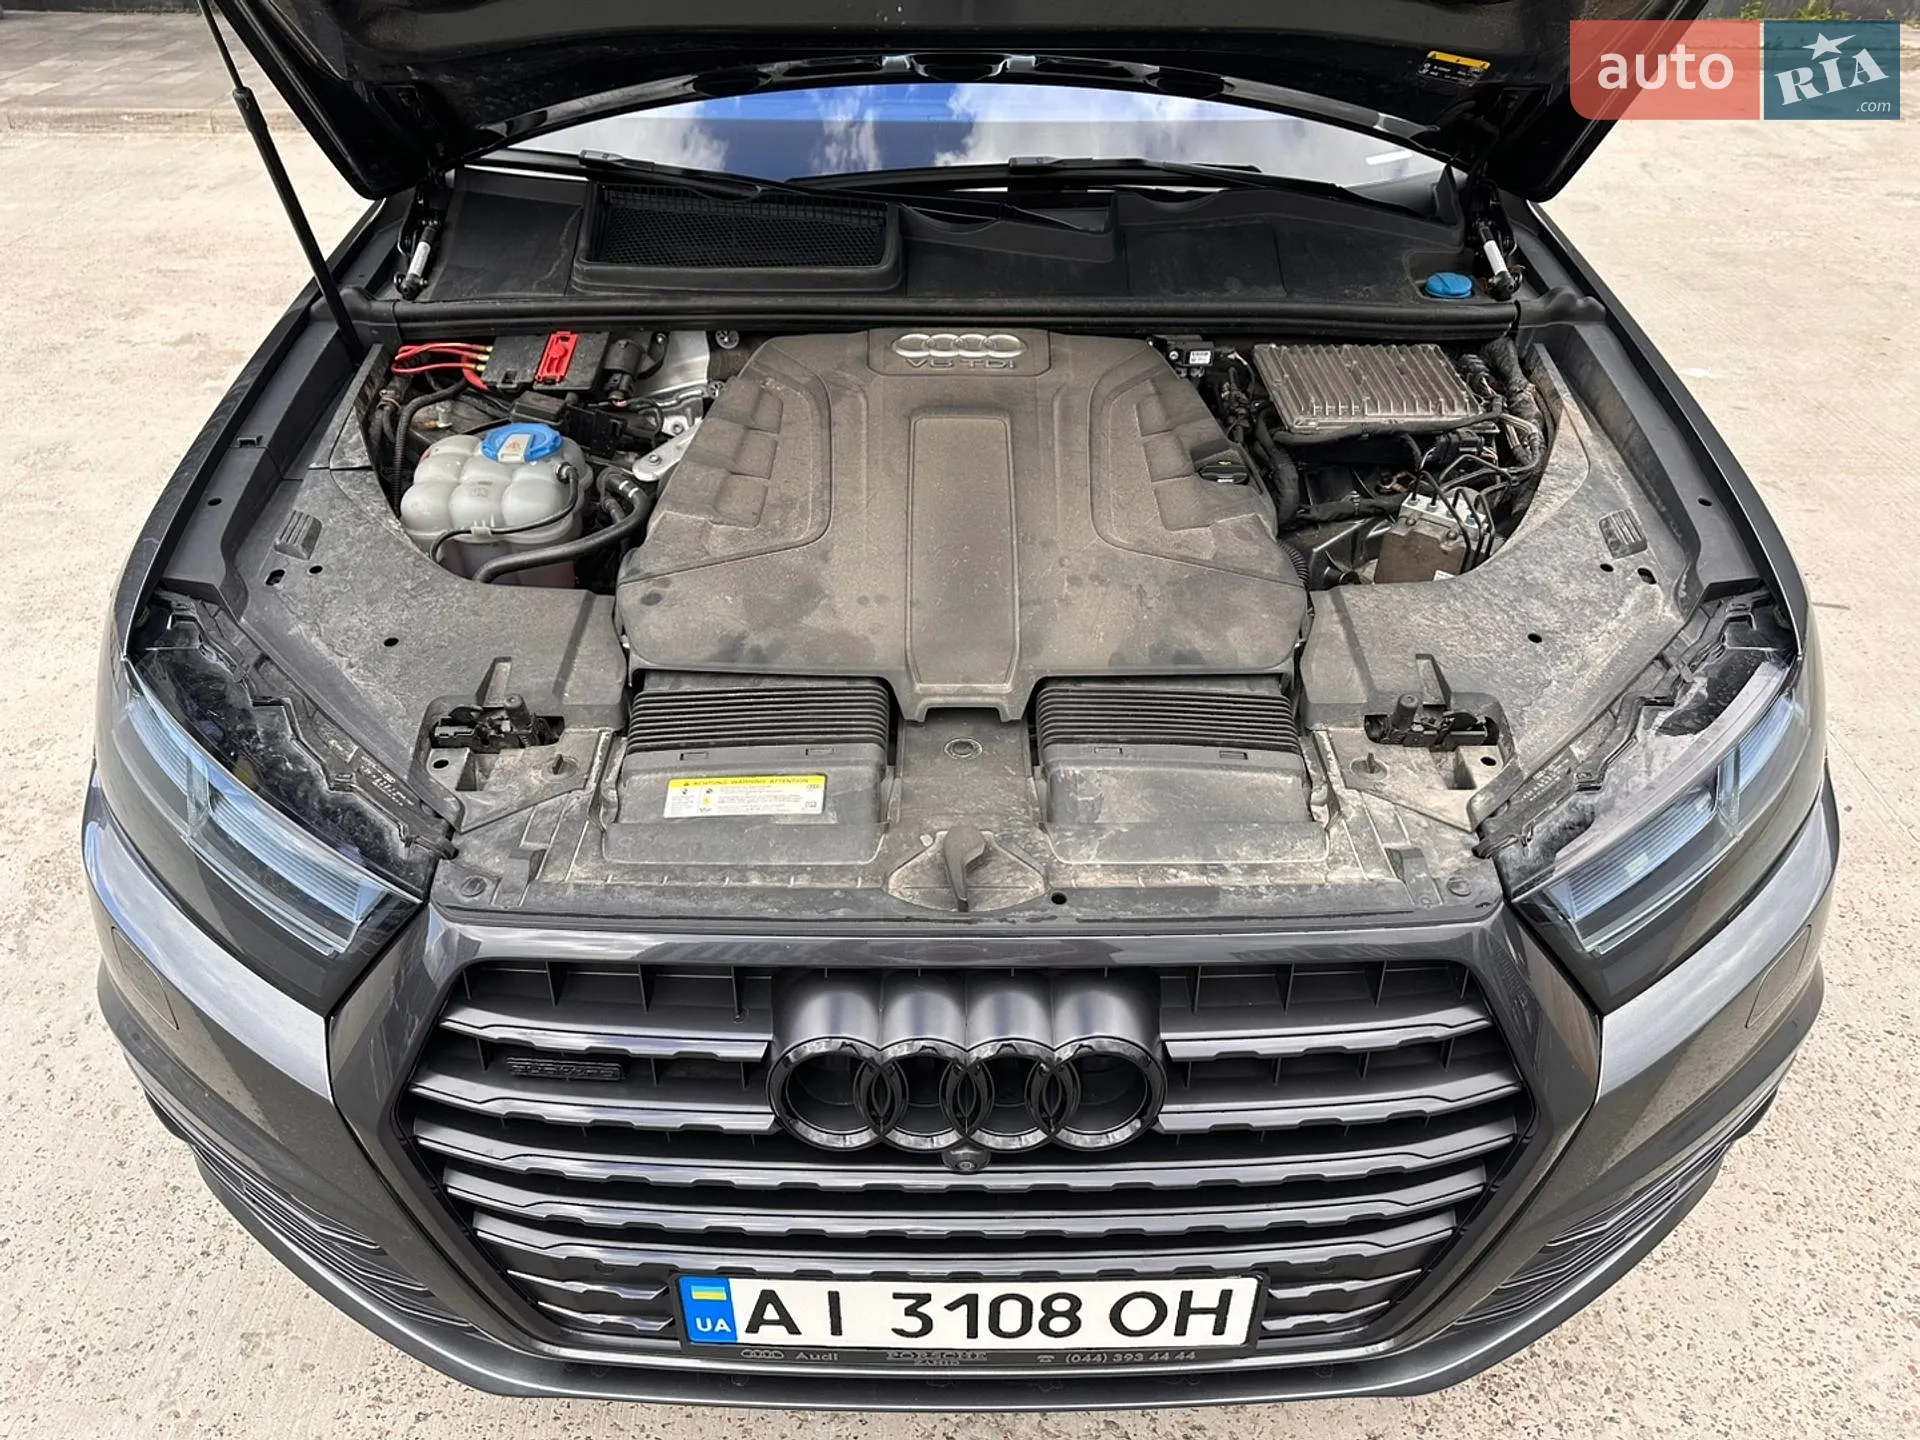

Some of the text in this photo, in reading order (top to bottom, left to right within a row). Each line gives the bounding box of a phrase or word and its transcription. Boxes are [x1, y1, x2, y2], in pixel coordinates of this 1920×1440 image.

[905, 358, 1016, 370] V6 TDI
[744, 1288, 1234, 1340] AI 3108 OH
[695, 1317, 731, 1333] UA
[794, 1352, 839, 1361] Audi
[1065, 1351, 1197, 1363] (044) 393 44 44
